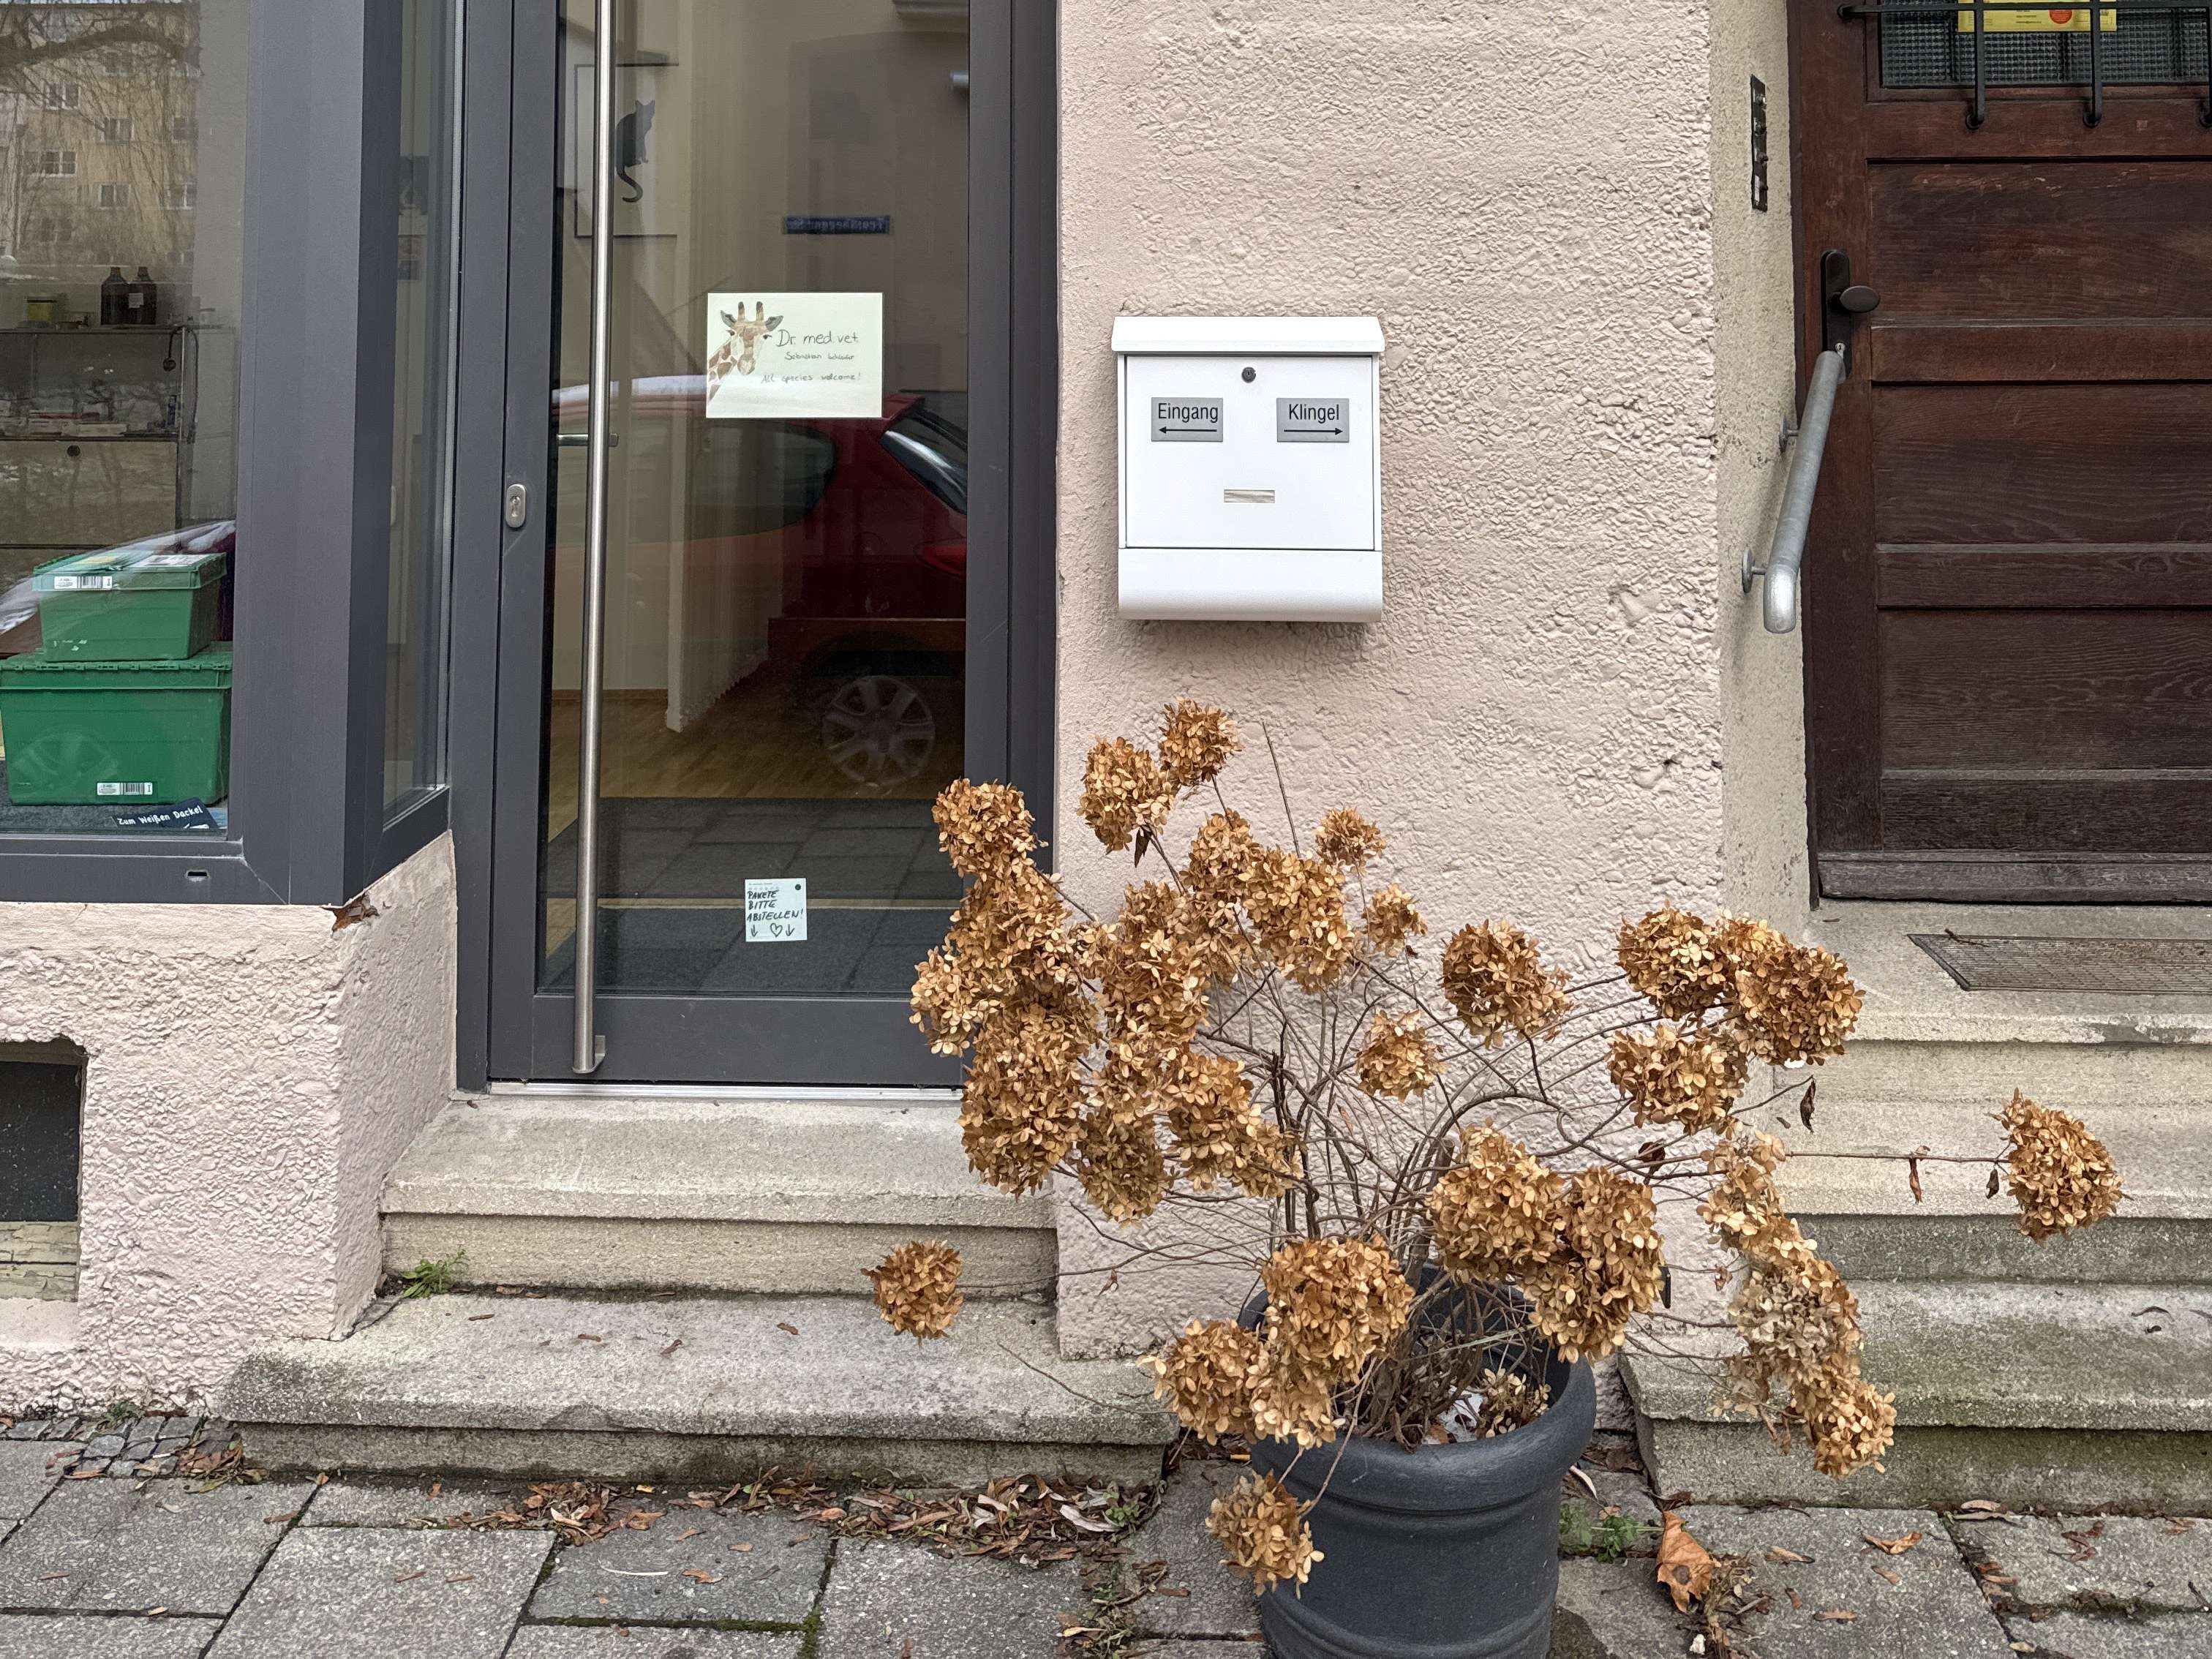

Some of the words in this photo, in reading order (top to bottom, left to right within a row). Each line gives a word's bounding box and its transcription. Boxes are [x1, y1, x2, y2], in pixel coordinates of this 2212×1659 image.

[775, 329, 796, 347] Dr.
[781, 375, 813, 384] species
[1158, 402, 1219, 423] Eingang
[1289, 403, 1339, 424] Klingel
[117, 817, 136, 825] Zum
[138, 814, 170, 824] Weißen
[172, 805, 203, 819] Dackel
[747, 889, 780, 899] PAKETE
[748, 900, 778, 910] BITTE
[747, 908, 803, 922] ABSTELLEN!
